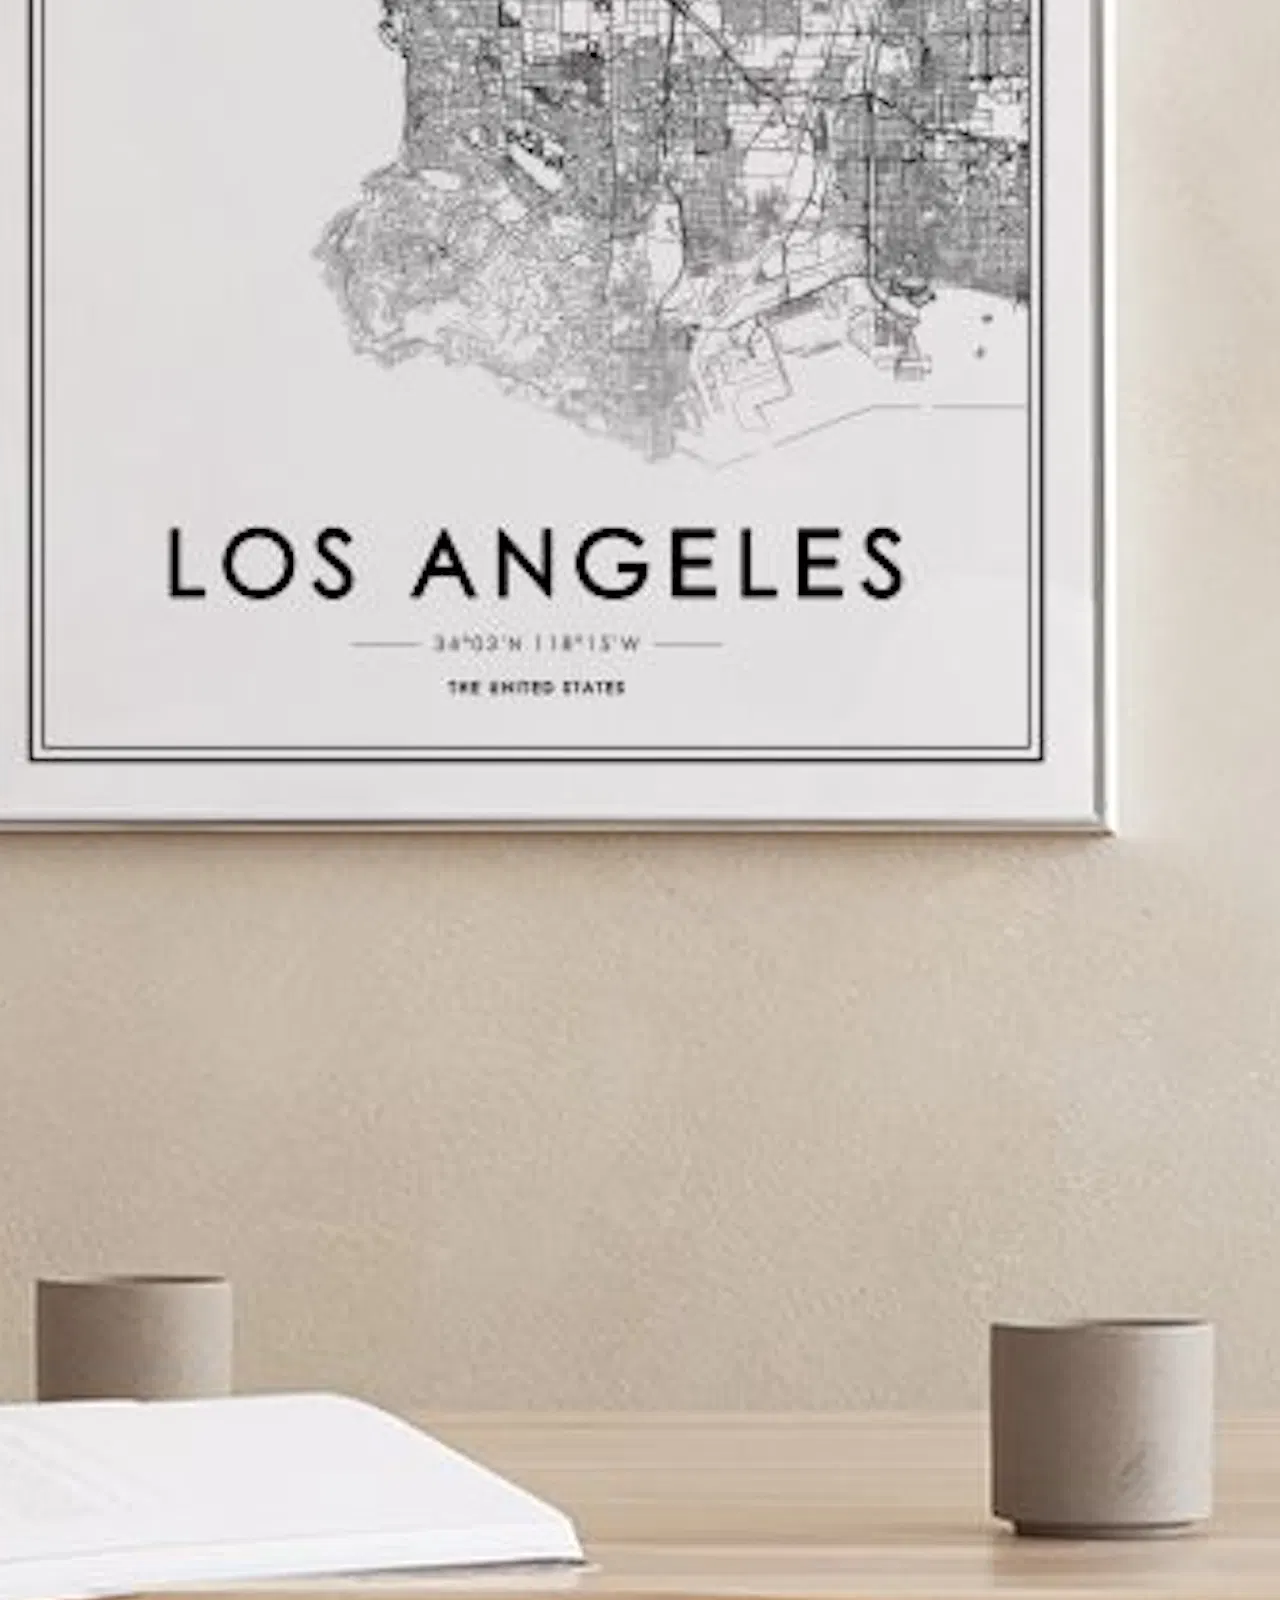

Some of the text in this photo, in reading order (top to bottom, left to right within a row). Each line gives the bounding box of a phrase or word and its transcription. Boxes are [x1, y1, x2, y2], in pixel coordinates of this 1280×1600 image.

[167, 525, 903, 601] LOS ANGELES
[446, 679, 625, 697] THE UNITED STATES
